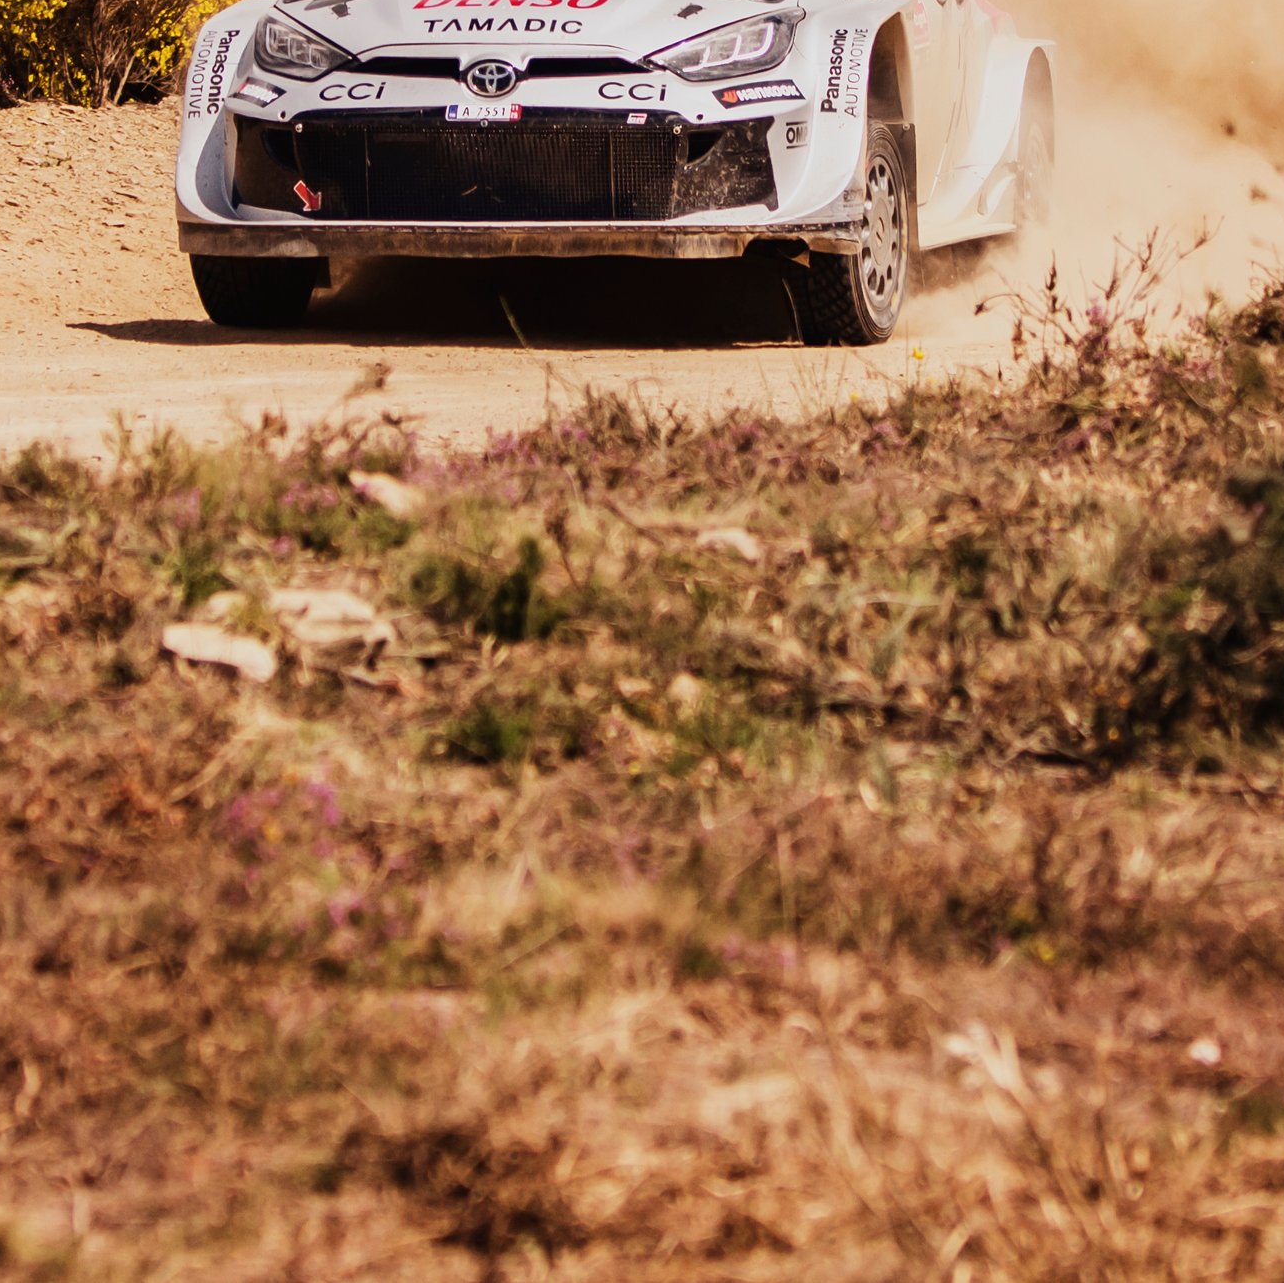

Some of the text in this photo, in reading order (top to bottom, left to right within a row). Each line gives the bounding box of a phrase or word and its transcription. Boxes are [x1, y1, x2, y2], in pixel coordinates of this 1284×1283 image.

[423, 18, 584, 35] TAMADIC
[188, 30, 217, 119] AUTOMOTIVE
[206, 29, 240, 115] Panasonic
[462, 106, 470, 117] A
[477, 107, 505, 117] 7551
[820, 28, 849, 113] Panasonic
[844, 28, 868, 117] AUTOMOTIVE
